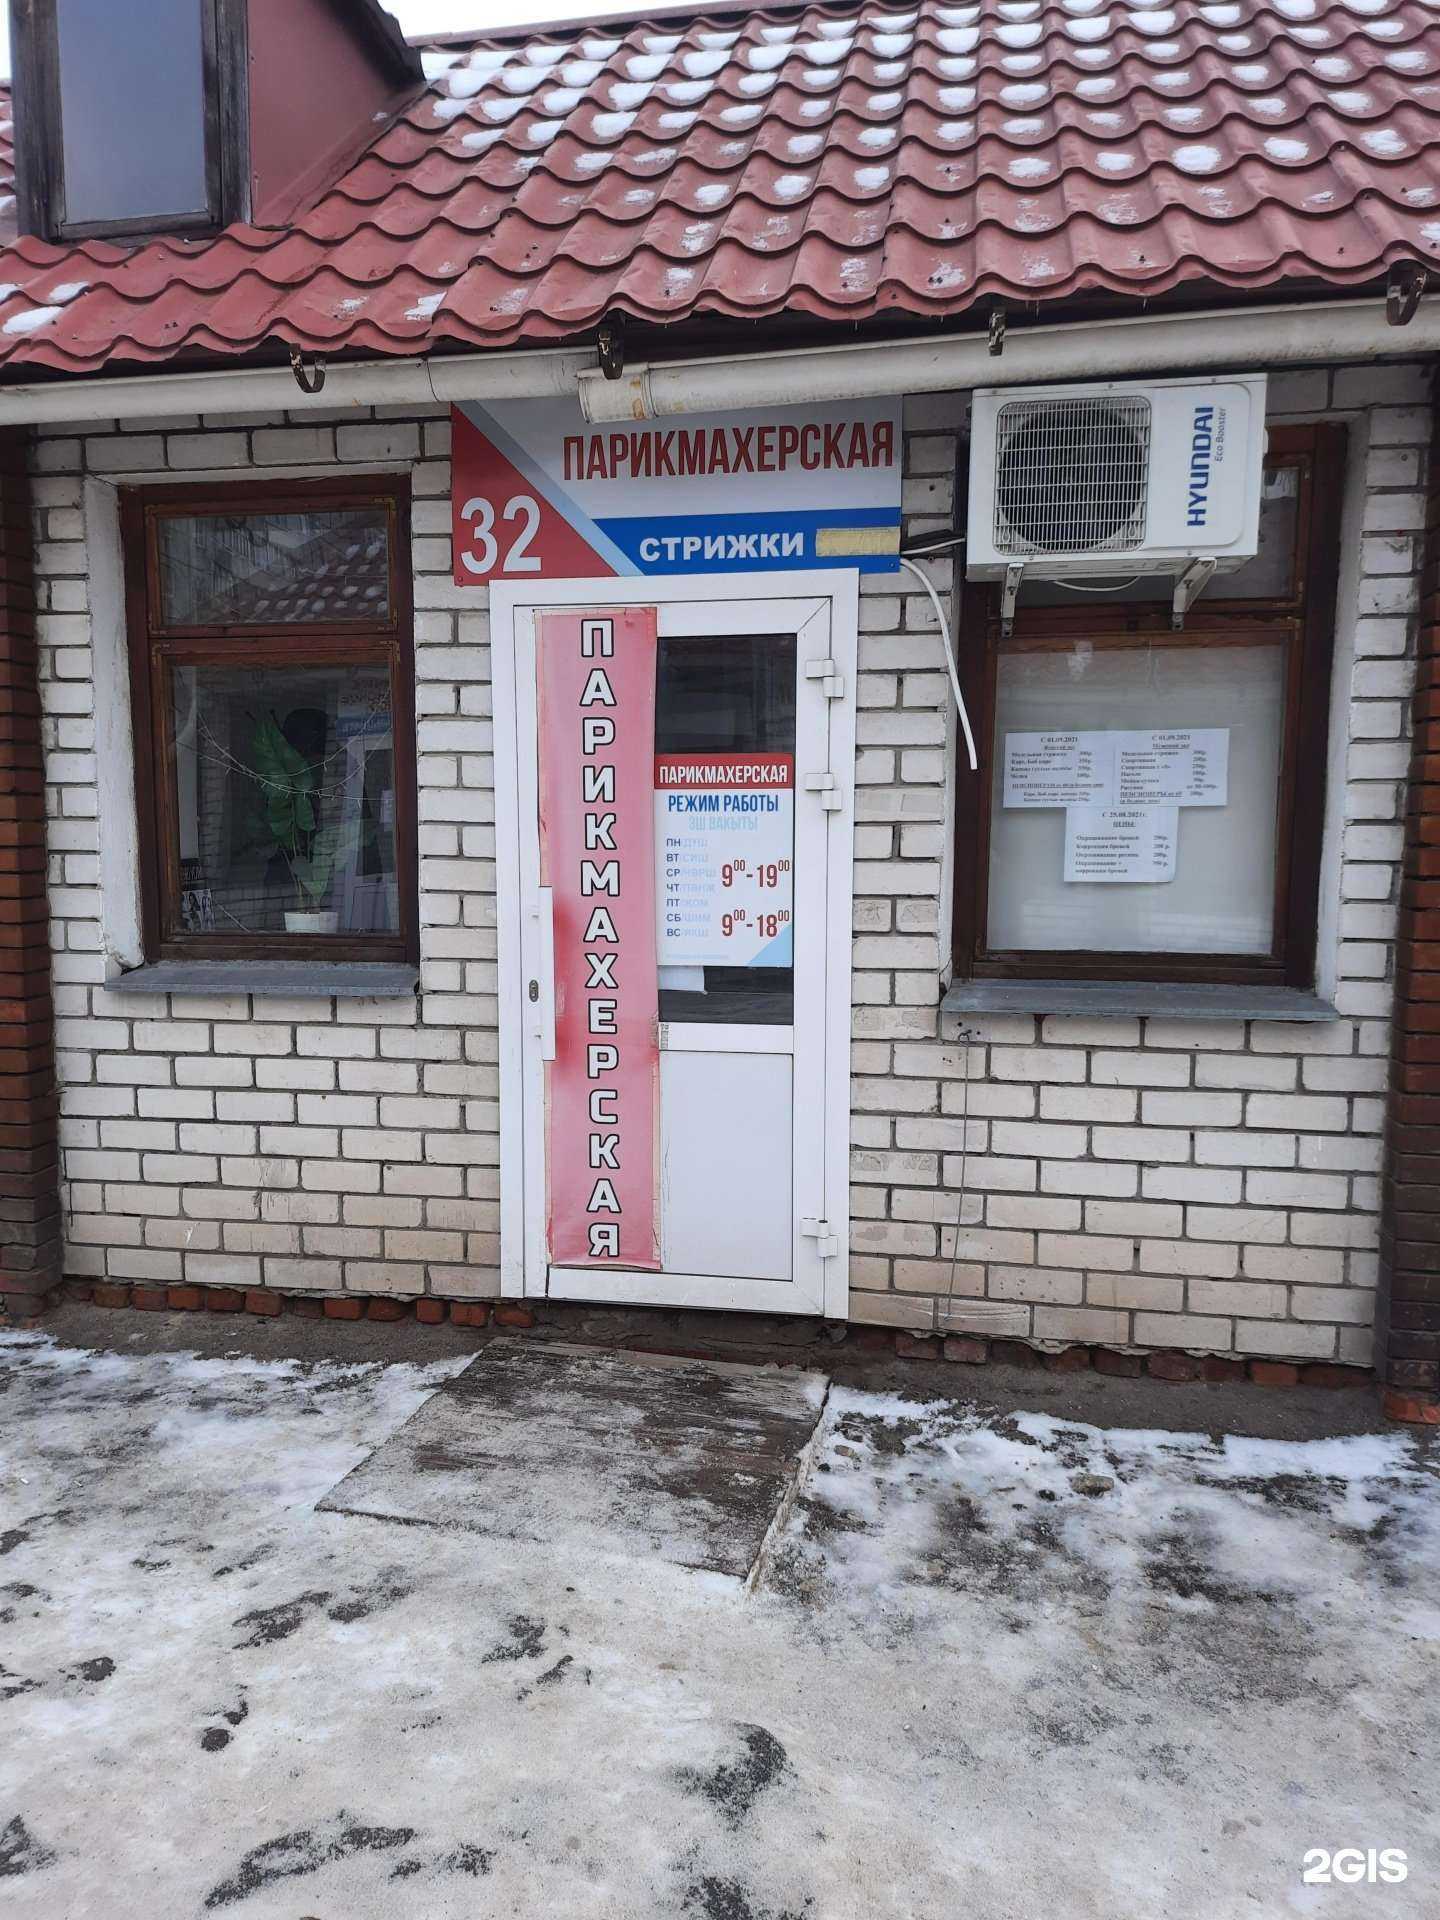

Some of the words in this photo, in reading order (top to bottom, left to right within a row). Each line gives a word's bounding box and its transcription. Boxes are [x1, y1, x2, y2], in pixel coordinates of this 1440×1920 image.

[1216, 407, 1227, 443] Booster
[563, 421, 894, 481] ПАРИКМАХЕРСКАЯ
[1186, 406, 1214, 527] HYUNDAI
[1214, 445, 1223, 462] Eco
[460, 494, 543, 575] 32
[639, 531, 805, 562] СТРИЖКИ
[659, 765, 788, 784] ПАРИКМАХЕРСКАЯ
[668, 795, 720, 813] РЕЖИМ
[723, 795, 779, 812] РАБОТЫ
[580, 619, 621, 1258] ПАРИКМАХЕРСКАЯ
